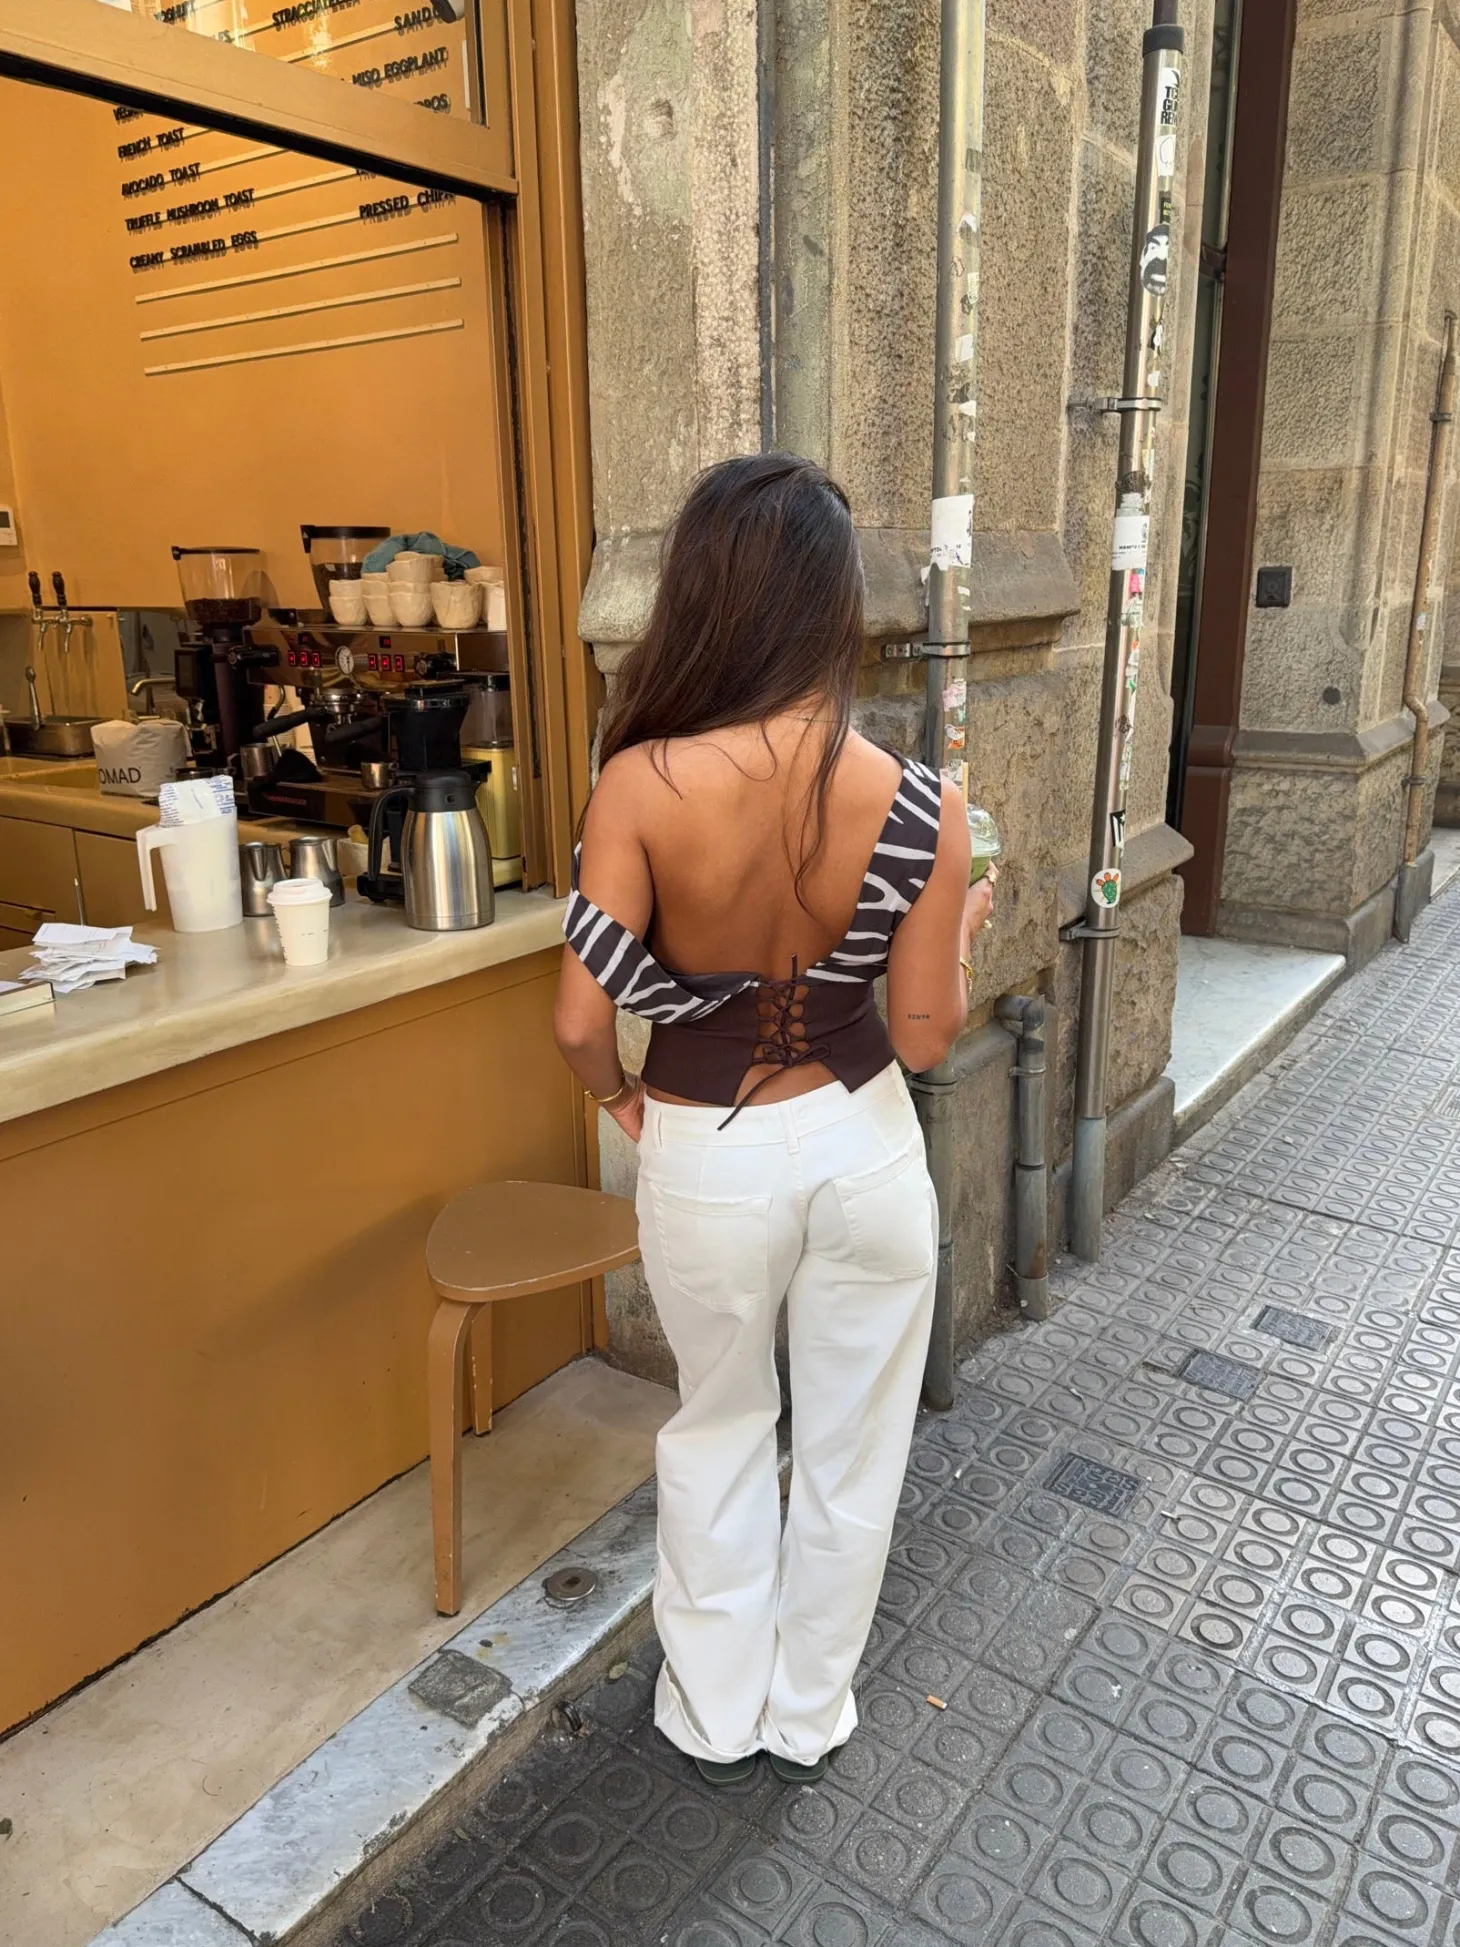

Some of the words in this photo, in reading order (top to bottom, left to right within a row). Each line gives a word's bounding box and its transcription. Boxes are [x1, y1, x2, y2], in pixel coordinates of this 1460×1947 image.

[384, 46, 447, 79] EGGPLANT
[118, 136, 151, 158] FRENCH
[156, 127, 184, 146] TOAST
[122, 173, 165, 195] AVOCADO
[169, 162, 200, 182] TOAST
[125, 211, 161, 231] TRUFFLE
[167, 198, 220, 220] MUSHROOM
[223, 188, 255, 207] TOAST
[359, 195, 409, 219] PRESSED
[130, 252, 164, 268] CREAMY
[170, 239, 226, 260] SCRAMBLED
[231, 231, 258, 248] EGGS
[98, 767, 141, 785] OMAD
